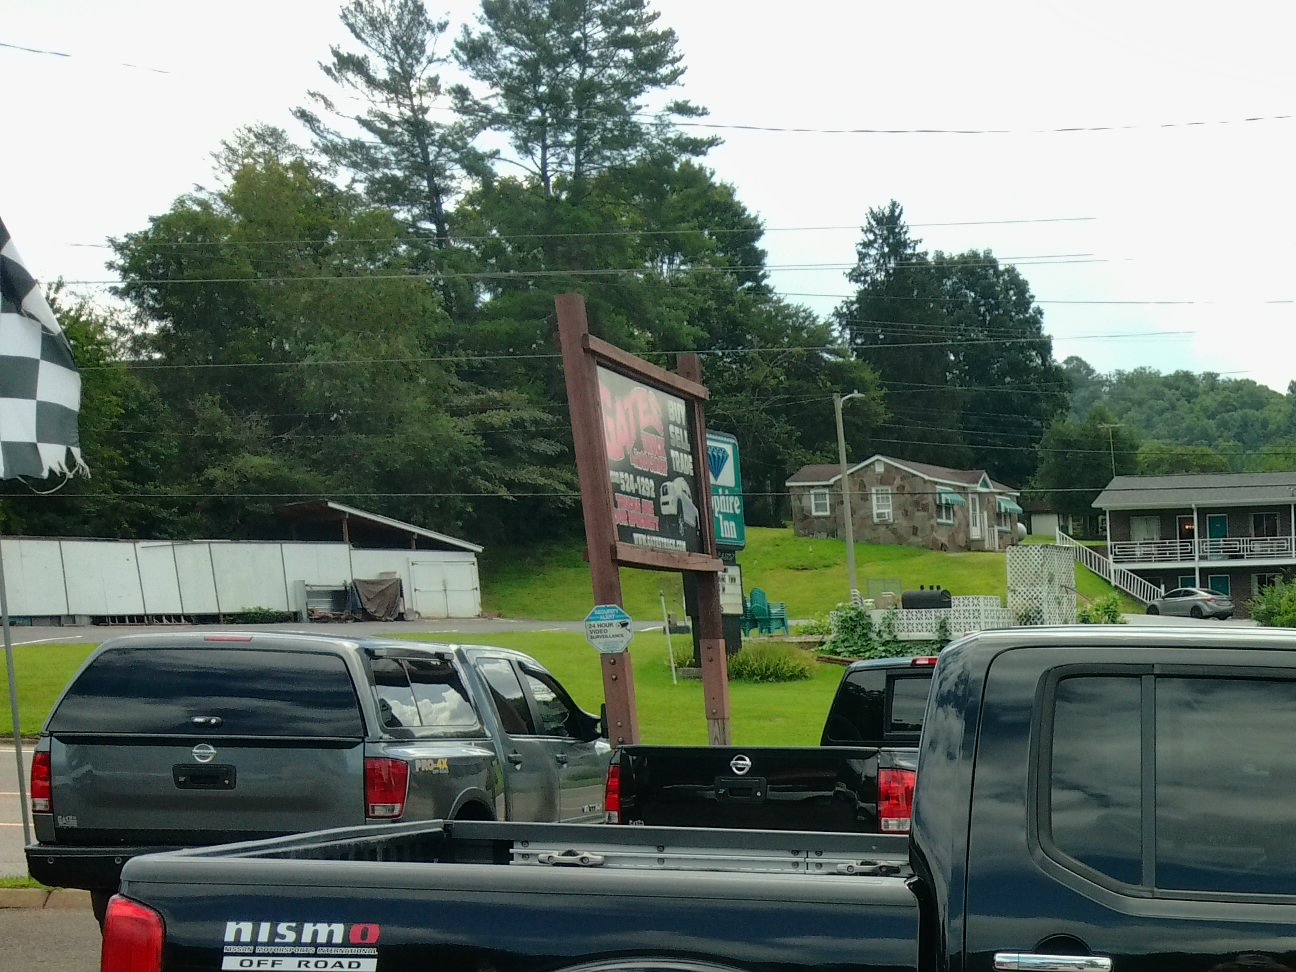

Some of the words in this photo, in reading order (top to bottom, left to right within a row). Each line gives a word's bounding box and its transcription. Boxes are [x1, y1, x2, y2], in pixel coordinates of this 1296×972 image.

[667, 399, 687, 426] BUY
[668, 423, 691, 452] SELL
[670, 448, 694, 477] TRADE
[619, 471, 656, 499] 524-1292
[711, 487, 741, 517] phire
[719, 513, 738, 539] Inn
[415, 757, 449, 773] PRO-4X
[223, 921, 381, 945] nismo
[239, 958, 284, 969] OFF
[297, 959, 362, 970] ROAD
